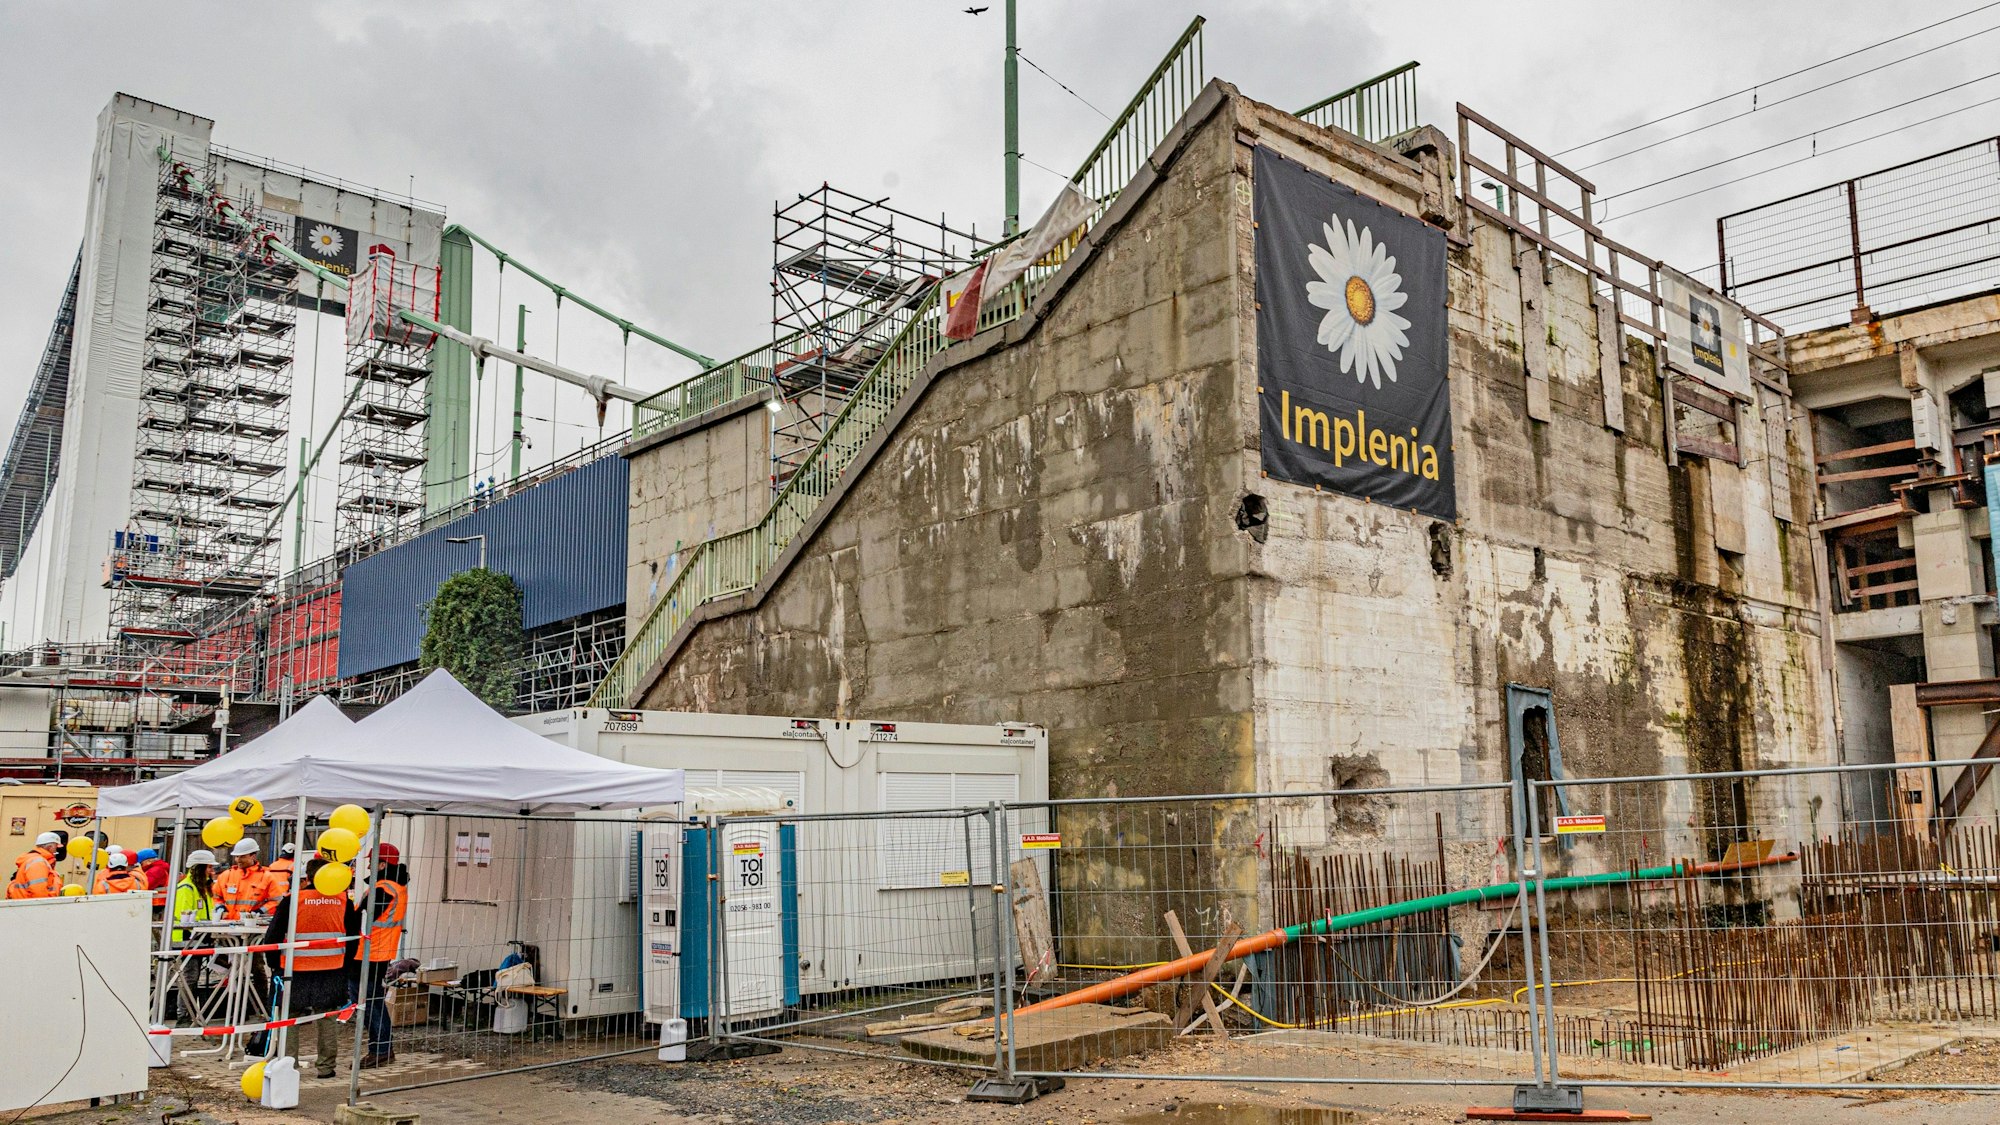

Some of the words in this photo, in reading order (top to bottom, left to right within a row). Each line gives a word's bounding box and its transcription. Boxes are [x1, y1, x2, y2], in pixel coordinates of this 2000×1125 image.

[1695, 345, 1723, 368] Implenia
[1281, 389, 1439, 481] Implenia
[603, 721, 638, 731] 707899
[782, 730, 828, 740] ela[containr]
[1000, 738, 1036, 746] ela[container]
[654, 859, 668, 873] TOI
[740, 858, 763, 872] TOI
[655, 873, 668, 887] TOI
[740, 873, 763, 887] TOI
[304, 896, 342, 906] Implenia
[763, 902, 771, 910] 00
